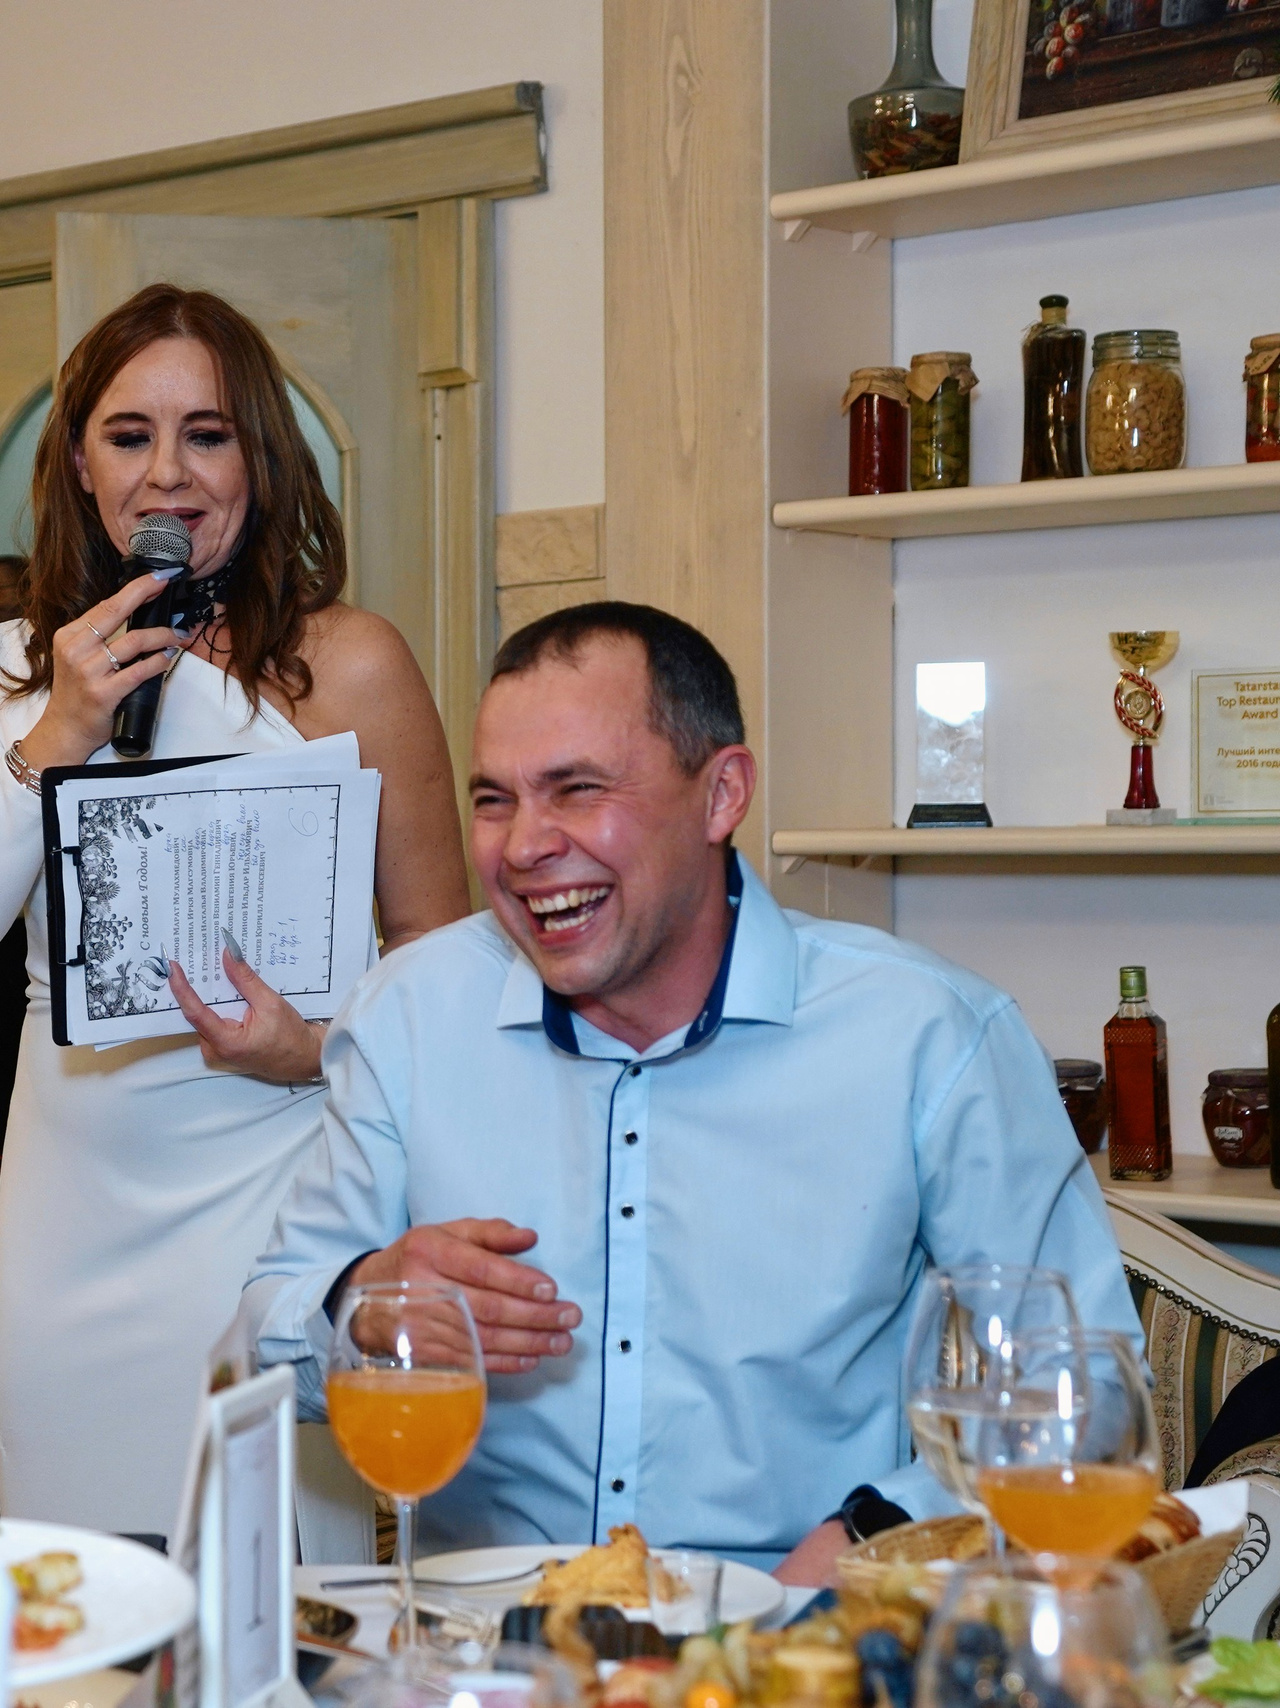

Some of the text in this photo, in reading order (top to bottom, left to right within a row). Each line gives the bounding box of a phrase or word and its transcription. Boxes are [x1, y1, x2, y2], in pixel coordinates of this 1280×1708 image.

[1217, 697, 1237, 708] Top
[1241, 709, 1279, 720] Award
[1217, 747, 1256, 758] Лучший
[1236, 759, 1259, 768] 2016
[228, 832, 236, 871] ЮРЬЕВНА
[136, 846, 151, 950] С новым Годом!
[227, 873, 235, 909] ЕВГЕНИЯ
[241, 877, 250, 909] ИЛЬДАР
[254, 852, 266, 966] СЫЧЕВ КИРИЛЛ АЛЕКСЕЕВИЧ
